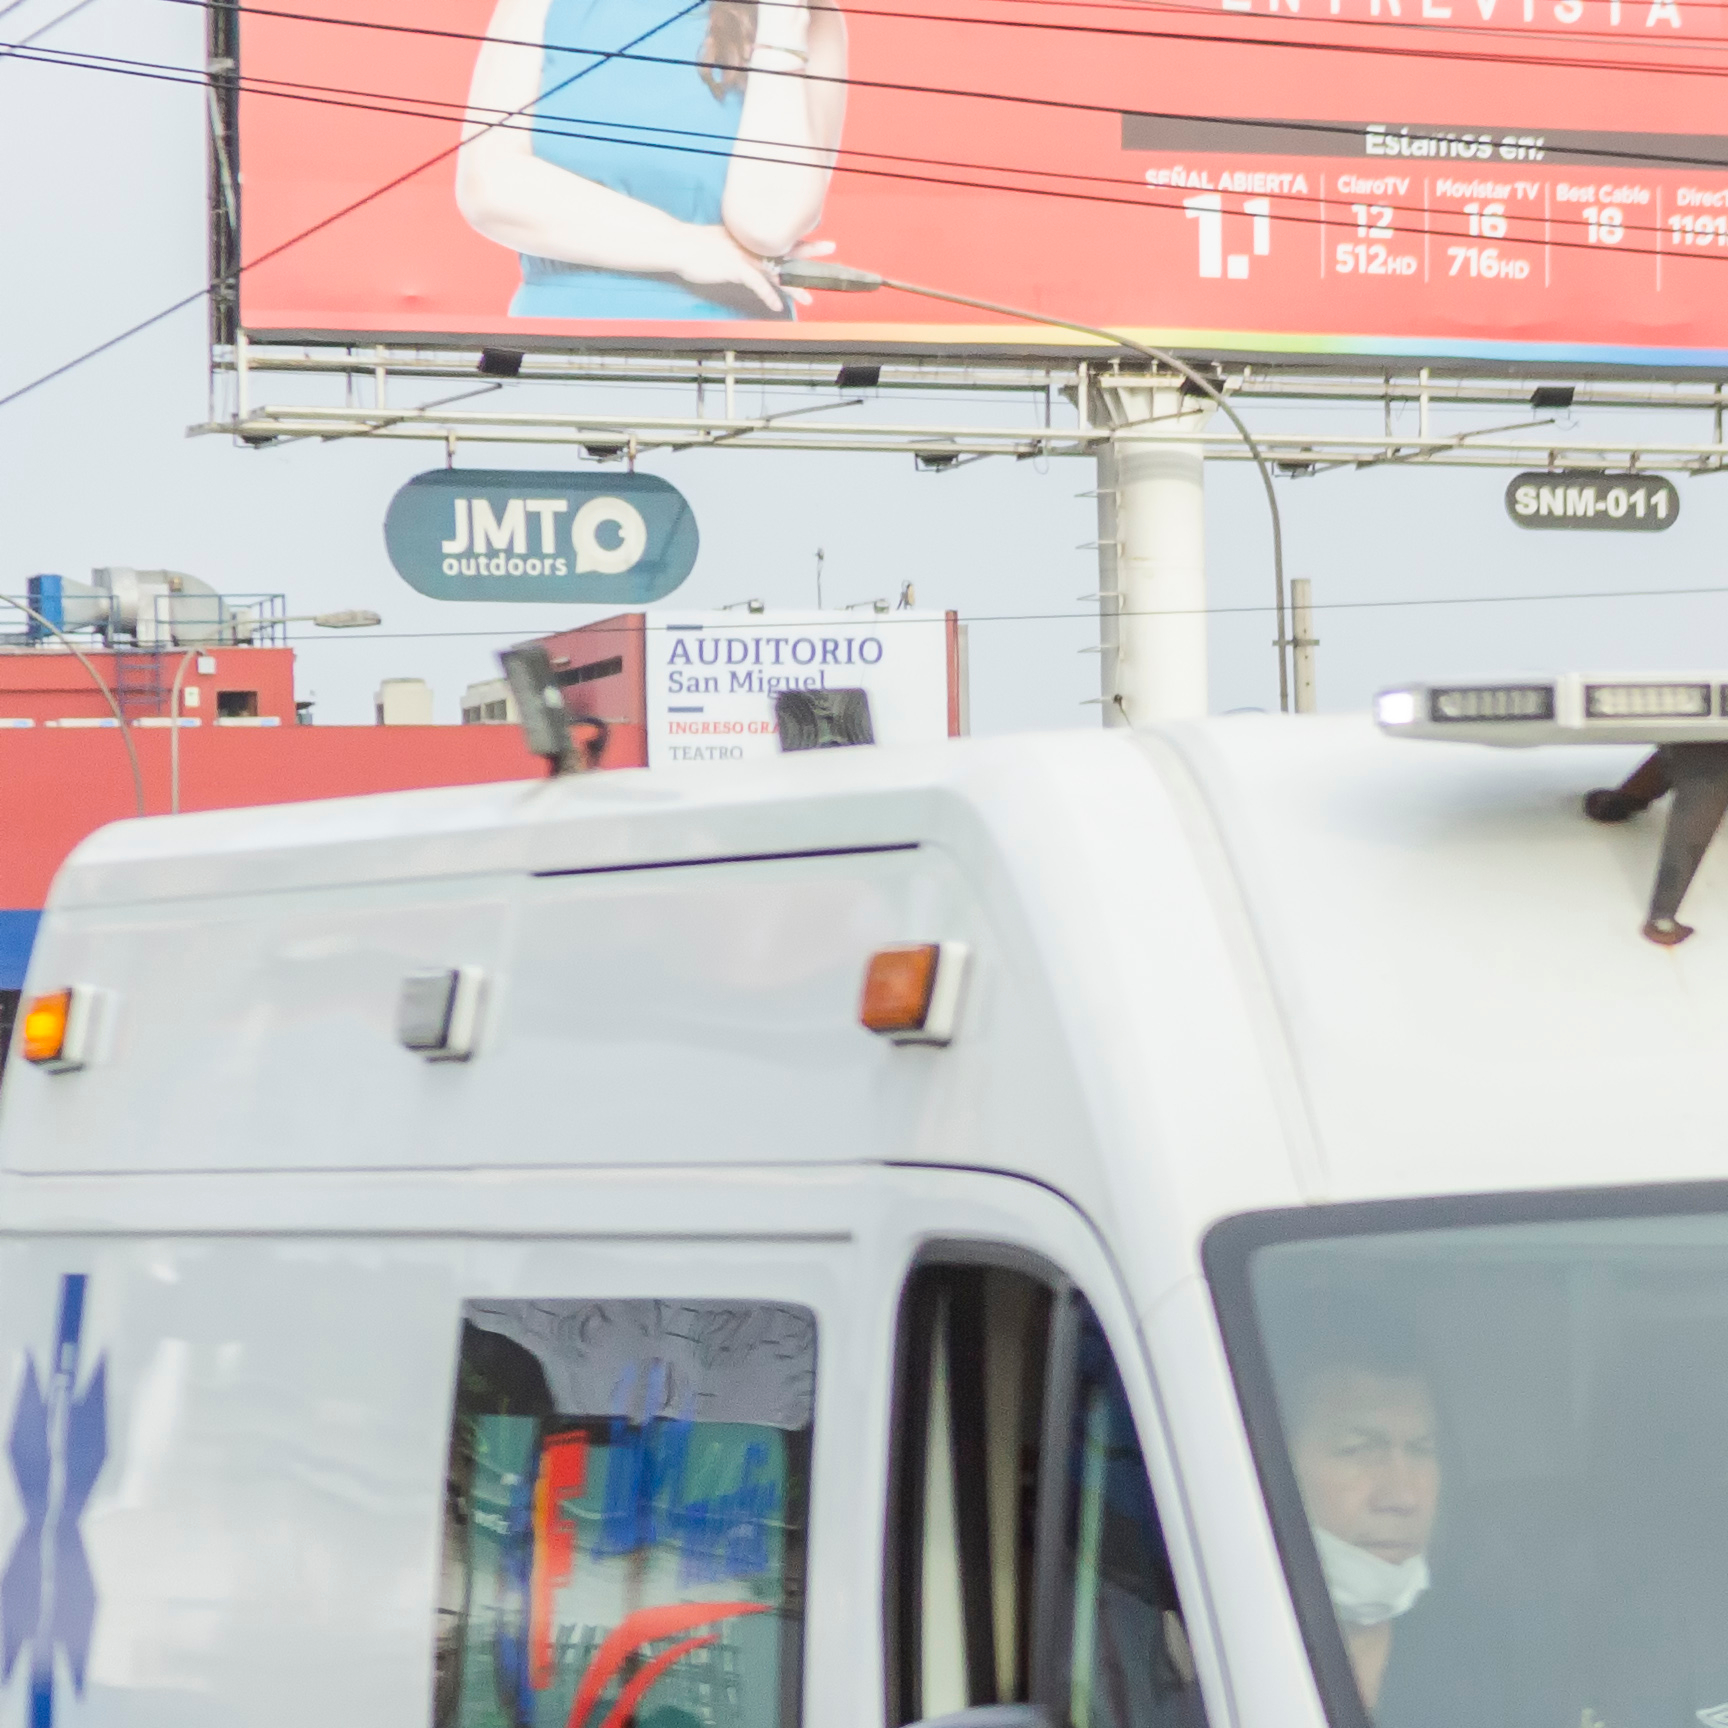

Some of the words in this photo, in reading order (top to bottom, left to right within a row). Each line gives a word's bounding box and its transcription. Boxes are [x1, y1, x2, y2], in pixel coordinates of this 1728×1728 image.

[1365, 124, 1493, 159] Estamos
[1145, 166, 1214, 191] SEÑAL
[1218, 171, 1309, 194] ABIERTA
[1337, 174, 1410, 195] ClaroTV
[1436, 177, 1511, 200] Movistar
[1514, 182, 1541, 200] TV
[1556, 182, 1596, 203] Best
[1599, 184, 1651, 205] Cable
[1352, 202, 1394, 239] 12
[1464, 202, 1507, 239] 16
[1582, 206, 1624, 244] 18
[1514, 485, 1668, 519] SNM-011
[442, 552, 568, 576] outdoors
[667, 637, 883, 665] AUDITORIO
[668, 670, 719, 694] San
[729, 669, 827, 699] Miguel
[668, 721, 743, 735] INGRESO
[669, 746, 743, 761] TEATRO
